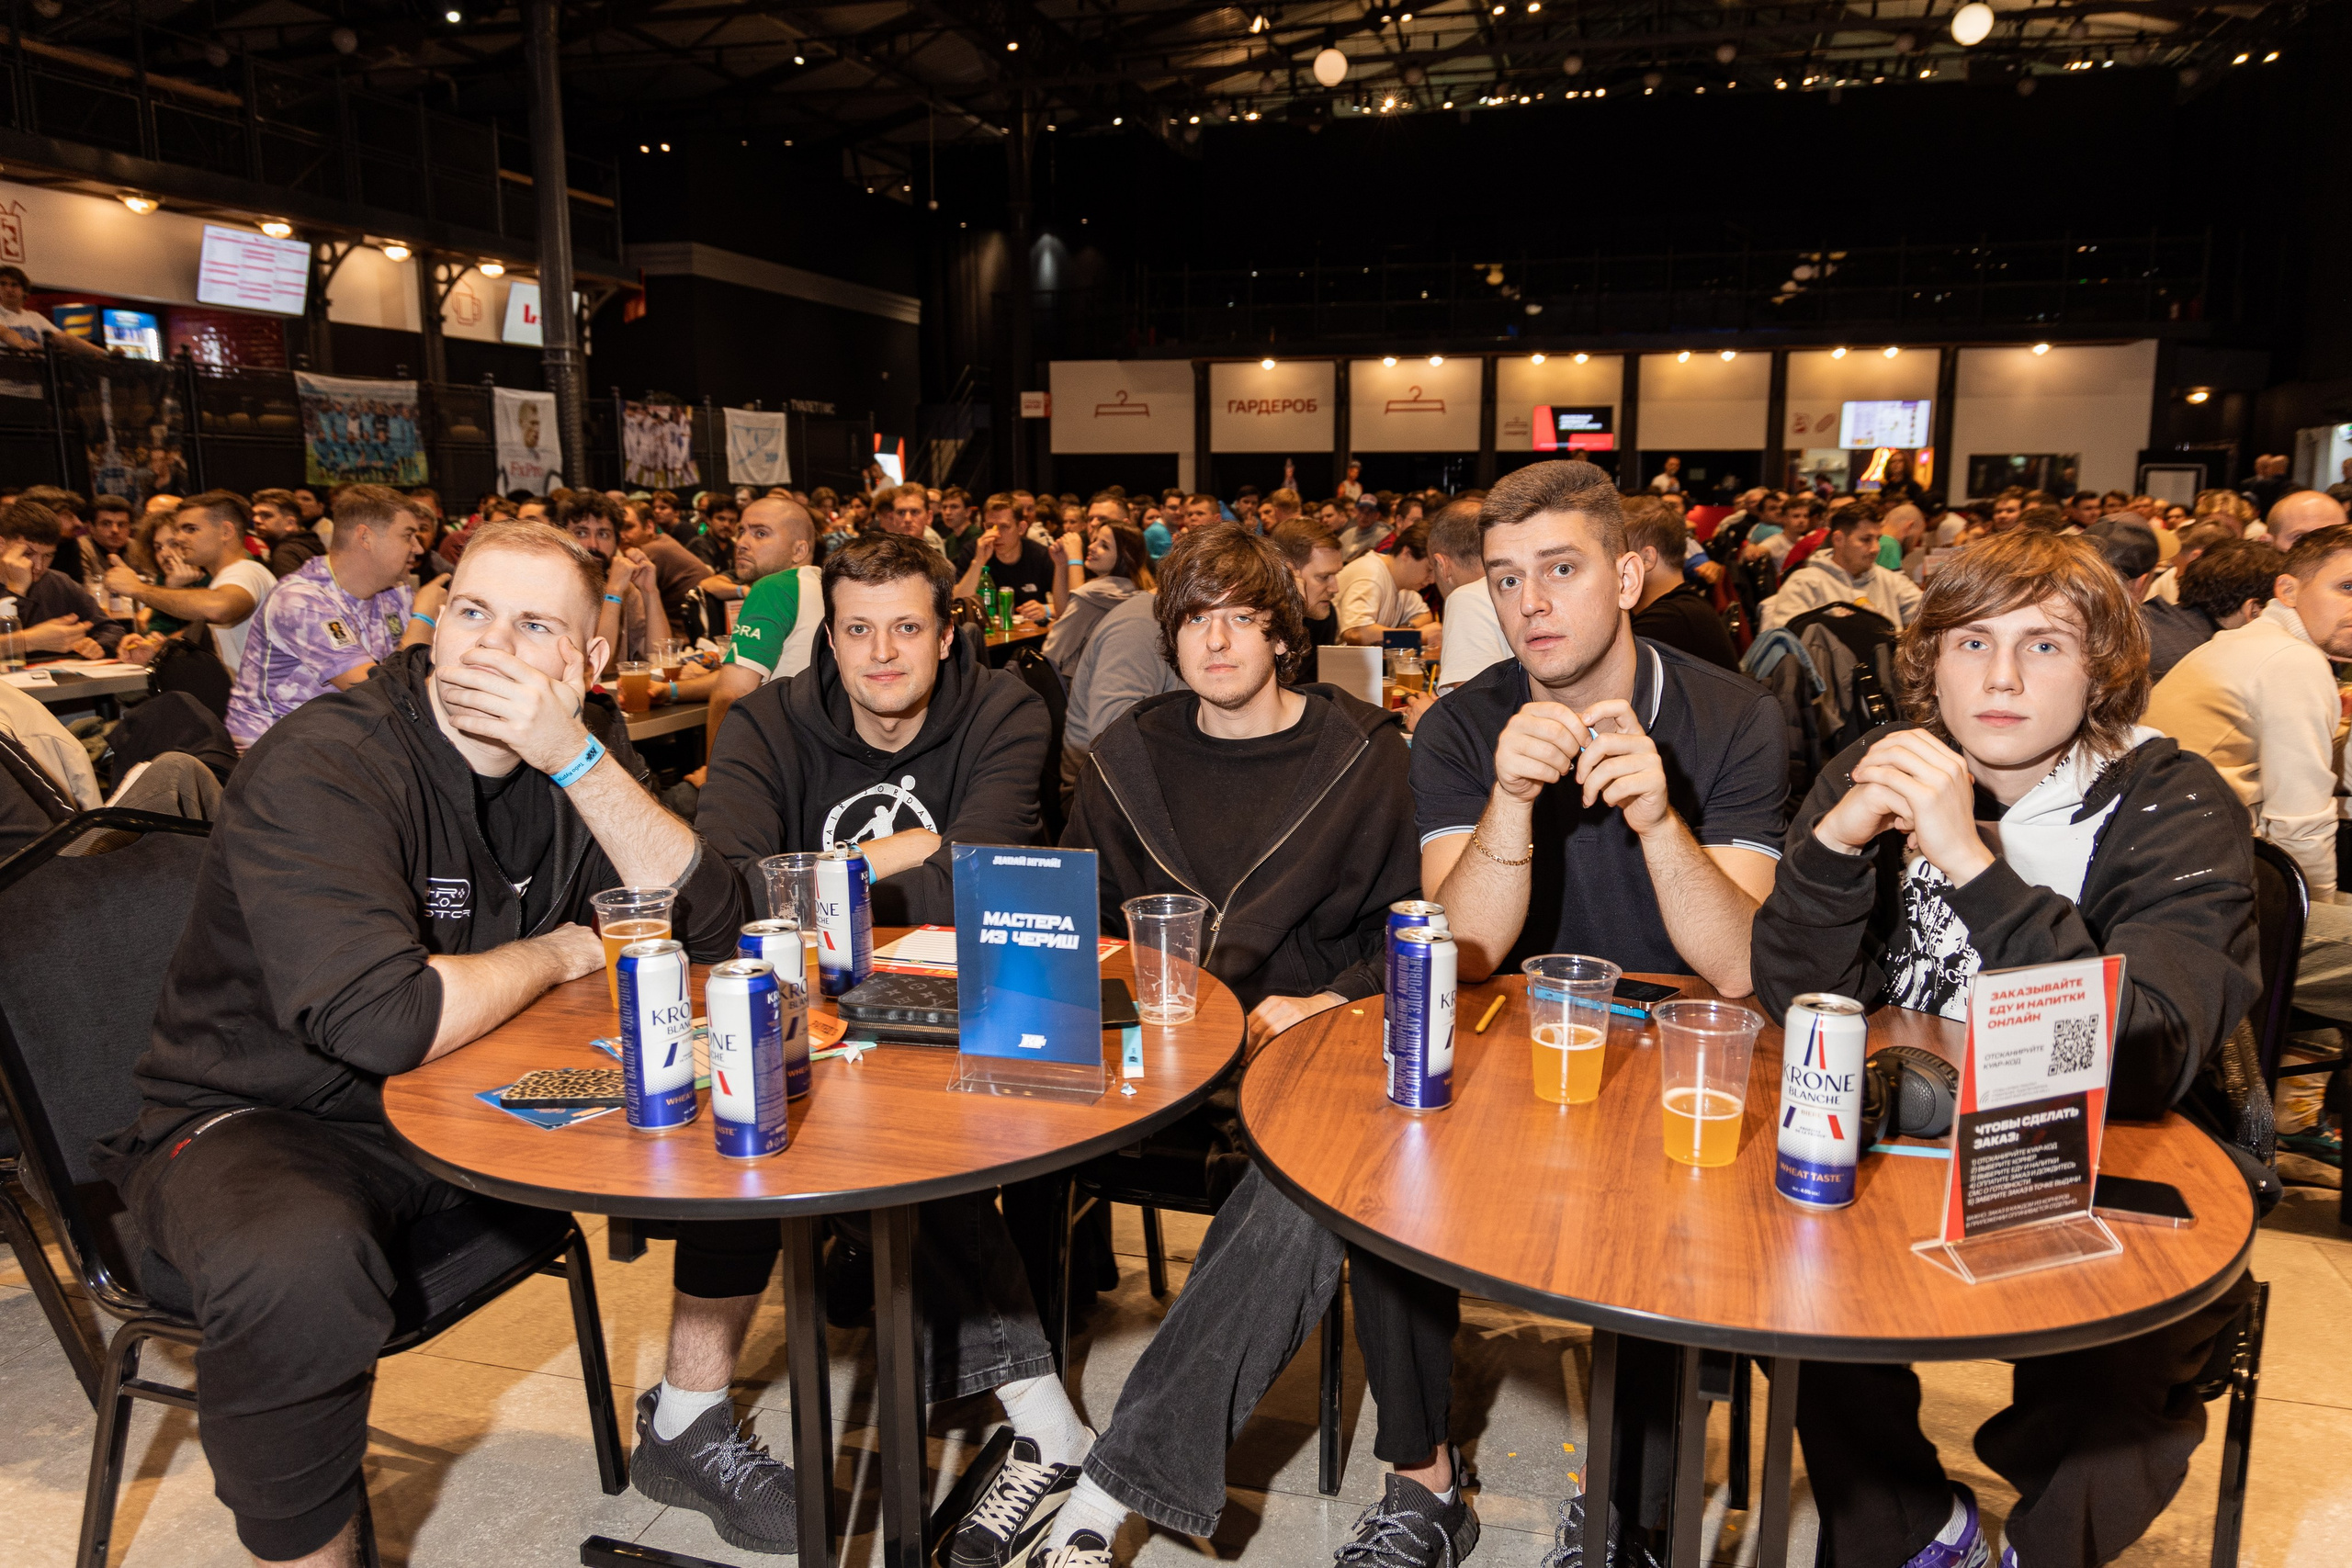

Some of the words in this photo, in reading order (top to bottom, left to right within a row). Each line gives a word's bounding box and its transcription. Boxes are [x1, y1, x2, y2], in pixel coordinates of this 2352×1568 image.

[1227, 399, 1318, 415] ГАРДЕРОБ
[826, 804, 846, 836] AIR
[864, 784, 934, 831] JORDAN
[982, 910, 1075, 931] МАСТЕРА
[979, 929, 1009, 945] ИЗ
[1012, 931, 1080, 951] ЧЕРИШ
[1397, 953, 1409, 995] АЛКОГОЛЯ
[1408, 957, 1424, 1014] ЗДОРОВЬЮ
[620, 970, 635, 1031] ЗДОРОВЬЮ
[1990, 977, 2084, 1001] ЗАКАЗЫВАЙТЕ
[1988, 1003, 2014, 1016] ЕДУ
[2016, 1002, 2026, 1010] И
[2027, 991, 2086, 1010] НАПИТКИ
[1396, 997, 1408, 1054] УПОТРЕБЛЕНИЕ
[1987, 1011, 2041, 1030] ОНЛАЙН
[1408, 1014, 1422, 1063] ВАШЕМУ
[624, 1032, 638, 1080] ВАШЕМУ
[1983, 1058, 2021, 1070] КУАР-КОД
[1984, 1045, 2045, 1061] ОТСКАНИРУЙТЕ
[1396, 1055, 1408, 1102] ЧРЕЗМЕРНОЕ
[1405, 1064, 1422, 1106] ВРЕДИТ
[1784, 1060, 1856, 1092] KRONE
[628, 1083, 640, 1124] ВРЕДИТ
[1788, 1085, 1841, 1105] BLANCHE
[1974, 1117, 2020, 1135] ЧТОБЫ
[2021, 1106, 2080, 1127] СДЕЛАТЬ
[1973, 1132, 2019, 1149] ЗАКАЗ:
[1976, 1149, 2027, 1166] ОТСКАНИРУЙТЕ
[2027, 1142, 2058, 1156] КУАР-КОД
[1977, 1160, 2011, 1173] ВЫБЕРИТЕ
[1780, 1161, 1810, 1180] WHEAT
[1810, 1171, 1842, 1183] TASTE
[1975, 1176, 2009, 1189] ОПЛАТИТЕ
[2009, 1170, 2030, 1181] ЗАКАЗ
[2035, 1161, 2076, 1178] ДОЖДИТЕСЬ
[1977, 1168, 2010, 1181] ВЫБЕРИТЕ
[2011, 1165, 2023, 1175] ЕДУ
[2023, 1163, 2030, 1171] И
[2030, 1156, 2060, 1170] НАПИТКИ
[1968, 1189, 1984, 1198] СМС
[1989, 1178, 2031, 1193] ГОТОВНОСТИ
[1975, 1190, 2007, 1205] ЗАБЕРИТЕ
[2007, 1186, 2028, 1199] ЗАКАЗ
[2028, 1184, 2033, 1192] В
